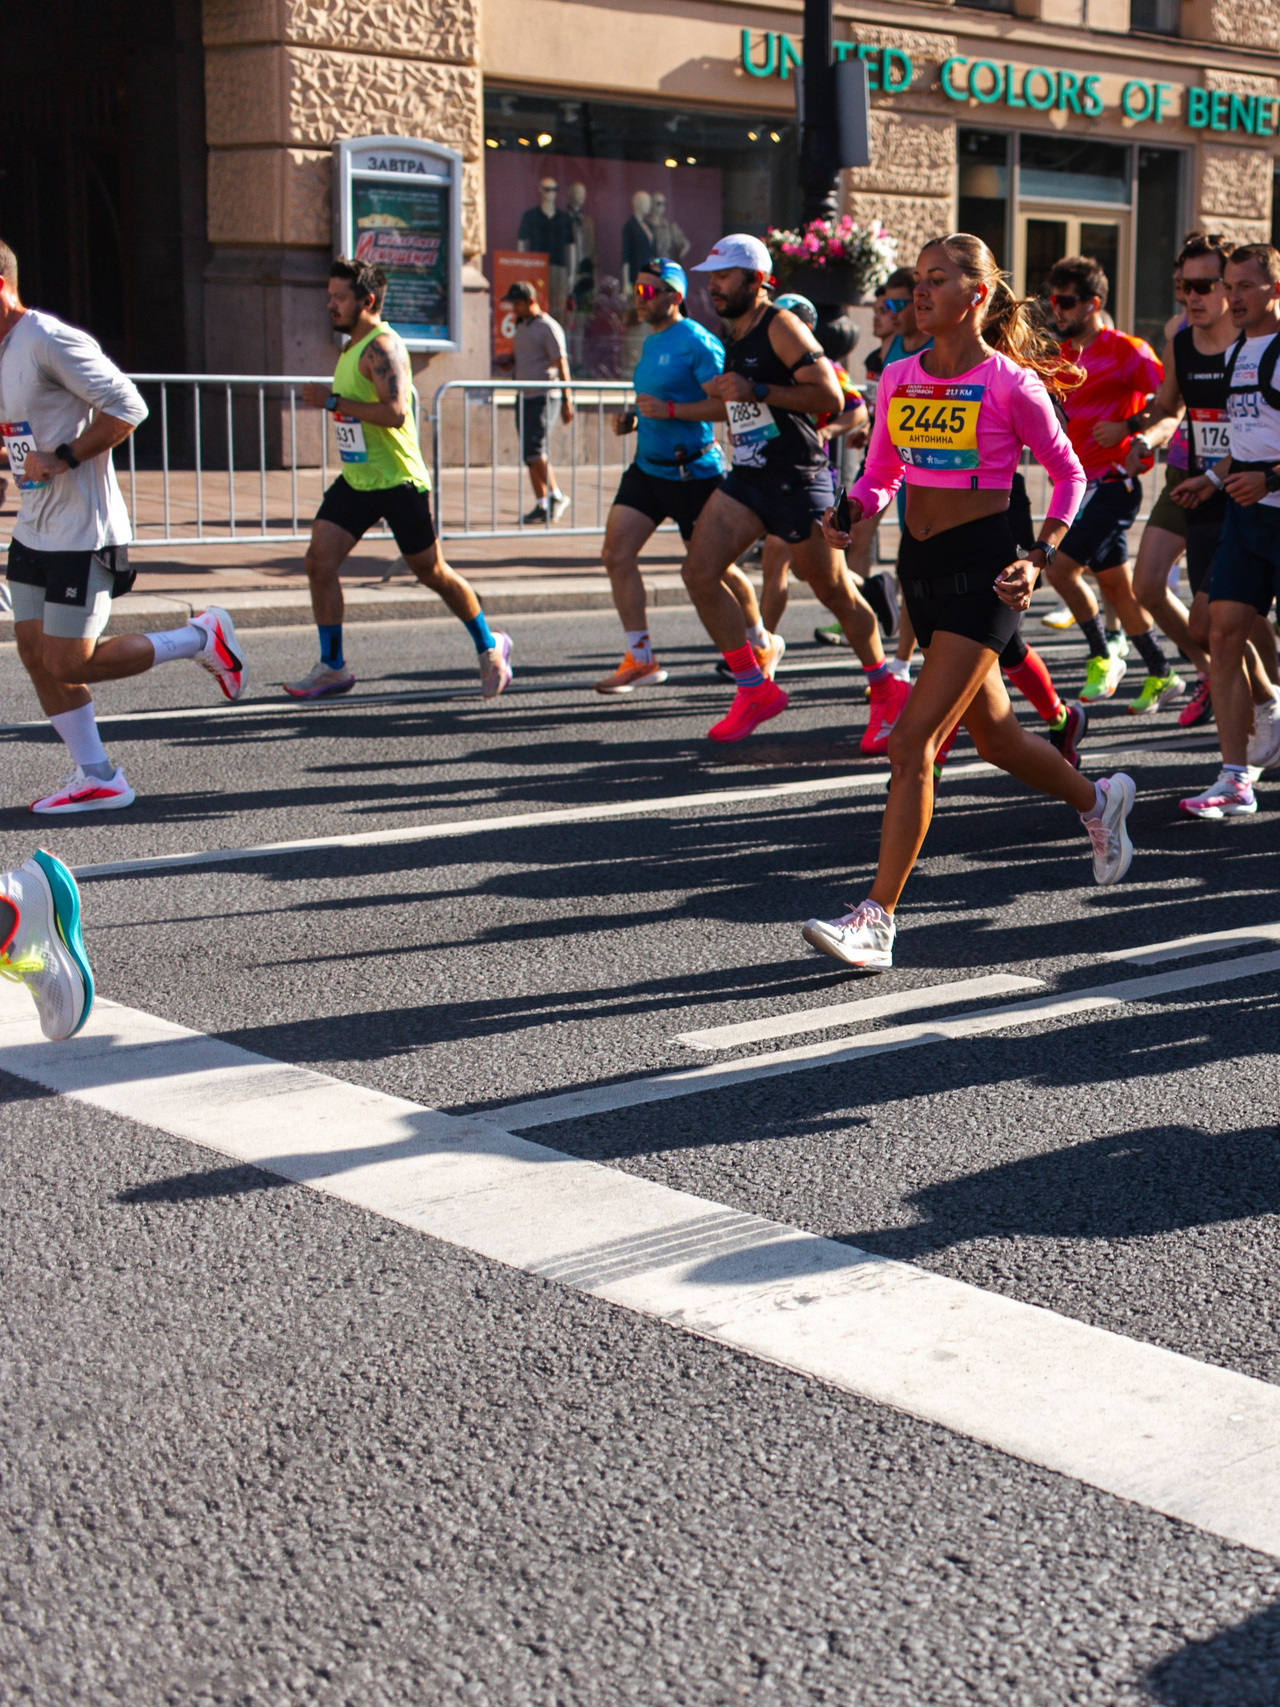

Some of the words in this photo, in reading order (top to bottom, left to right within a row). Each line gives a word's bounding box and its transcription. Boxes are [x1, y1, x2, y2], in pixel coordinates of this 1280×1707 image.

[741, 29, 912, 93] UNTED
[941, 56, 1104, 117] COLORS
[1121, 80, 1174, 123] OF
[368, 157, 426, 174] ЗАВТРА
[500, 312, 516, 339] 6
[899, 405, 966, 433] 2445
[909, 435, 954, 444] АНТОНИНА
